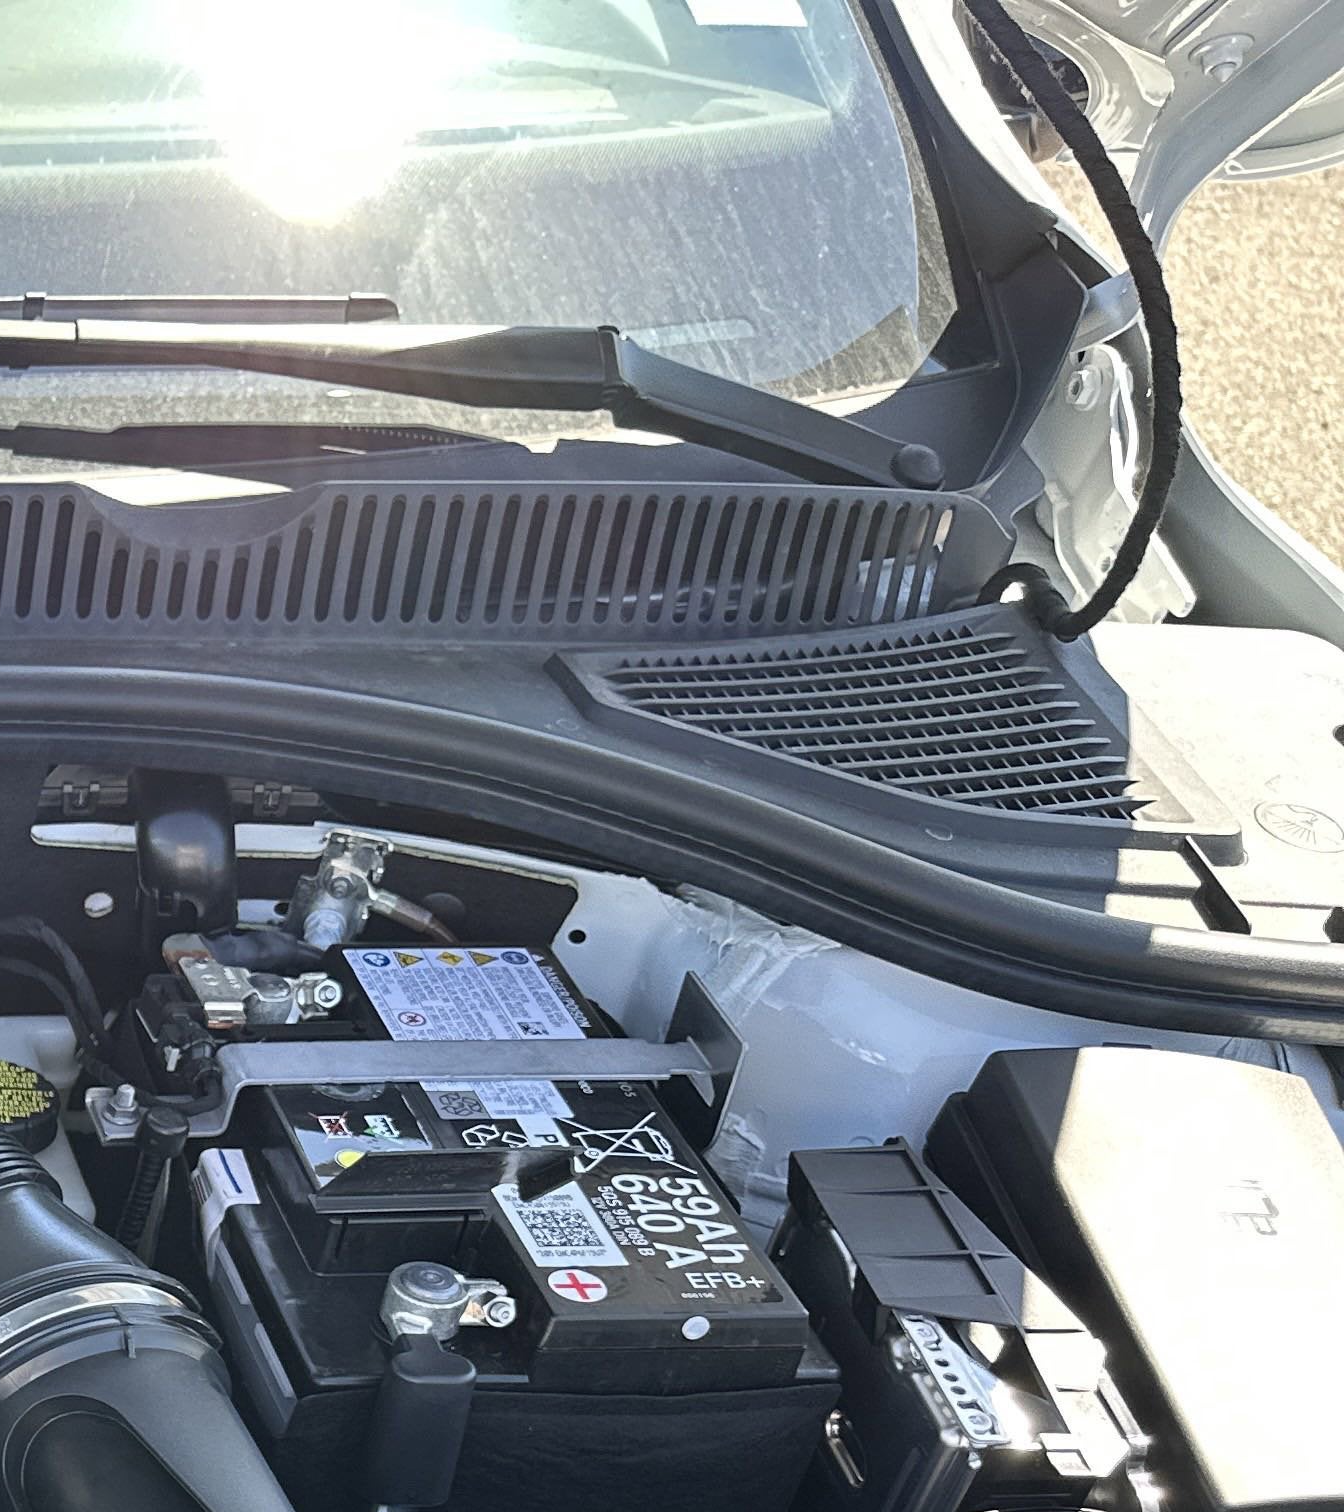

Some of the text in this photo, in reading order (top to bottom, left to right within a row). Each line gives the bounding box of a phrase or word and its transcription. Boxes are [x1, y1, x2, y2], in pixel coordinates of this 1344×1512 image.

[609, 1172, 706, 1270] 640 A
[660, 1176, 750, 1266] 59Ah
[685, 1271, 765, 1289] EFB+
